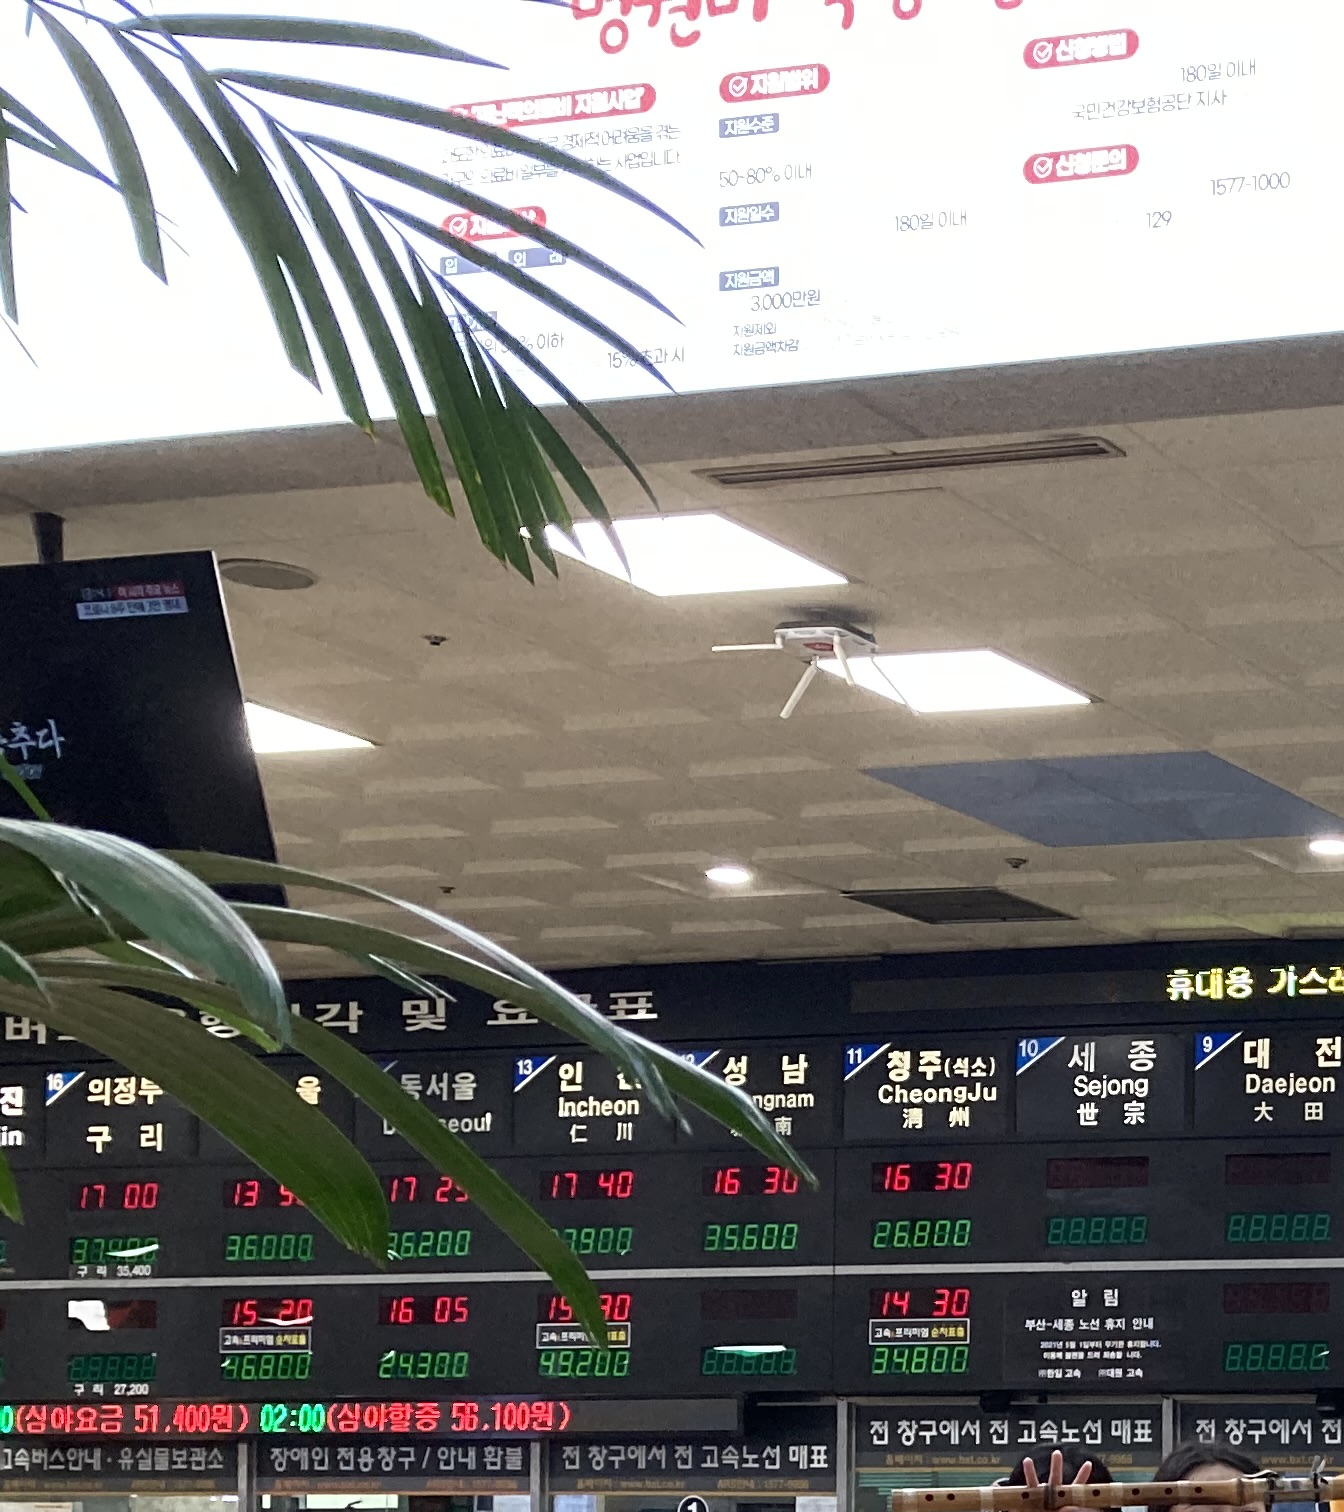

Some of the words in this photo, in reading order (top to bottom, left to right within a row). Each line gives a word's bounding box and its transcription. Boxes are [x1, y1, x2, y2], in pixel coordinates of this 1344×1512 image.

[1180, 58, 1222, 83] 180일
[1225, 57, 1257, 80] 이내
[1072, 93, 1192, 122] 국민건강보험공단
[1195, 89, 1228, 110] 지사
[724, 114, 776, 136] 지원수준
[1209, 170, 1291, 197] 1577-1000
[724, 203, 776, 224] 지원일수
[894, 212, 935, 232] 180일
[939, 209, 968, 228] 이내
[1145, 208, 1173, 230] 129
[724, 267, 776, 289] 지원금액
[750, 288, 822, 313] 3,000만원
[1165, 967, 1254, 1001] 휴대용
[401, 1002, 447, 1032] 및
[846, 1046, 862, 1065] 11
[1018, 1039, 1039, 1058] 10
[1201, 1035, 1214, 1054] 9
[517, 1059, 534, 1076] 13
[46, 1074, 64, 1091] 16
[87, 1076, 164, 1106] 의정부
[877, 1082, 998, 1104] CheongJu
[1072, 1073, 1150, 1099] Sejong
[1244, 1071, 1336, 1097] Daejeon
[557, 1095, 639, 1118] Incheon
[551, 1172, 578, 1199] 17
[598, 1170, 634, 1199] 40
[715, 1167, 741, 1196] 16
[883, 1164, 912, 1191] 16
[933, 1162, 973, 1190] 30
[79, 1184, 106, 1209] 17
[123, 1182, 158, 1209] 00
[232, 1181, 259, 1206] 13
[389, 1177, 416, 1203] 17
[116, 1265, 152, 1278] 35,400
[232, 1301, 257, 1327] 15
[389, 1297, 415, 1324] 16
[434, 1296, 469, 1324] 05
[881, 1290, 911, 1317] 14
[932, 1288, 972, 1318] 30
[1024, 1316, 1075, 1331] 부산-세종
[1078, 1316, 1101, 1330] 노선
[1104, 1316, 1126, 1330] 휴지
[1131, 1316, 1154, 1330] 안내
[113, 1382, 150, 1396] 27,200
[868, 1419, 890, 1446] 전
[896, 1419, 982, 1446] 창구에서
[989, 1419, 1010, 1446] 전
[1017, 1418, 1103, 1445] 고속노선
[1111, 1418, 1154, 1445] 매표
[1195, 1418, 1217, 1445] 전
[1223, 1418, 1313, 1445] 창구에서
[1321, 1418, 1343, 1445] 전
[270, 1446, 329, 1473] 장애인
[336, 1446, 416, 1472] 전용창구
[437, 1446, 477, 1471] 안내
[482, 1446, 524, 1471] 환불
[561, 1444, 581, 1470] 전
[587, 1444, 668, 1470] 창구에서
[673, 1444, 694, 1470] 전
[701, 1444, 782, 1470] 고속노선
[788, 1444, 829, 1470] 매표
